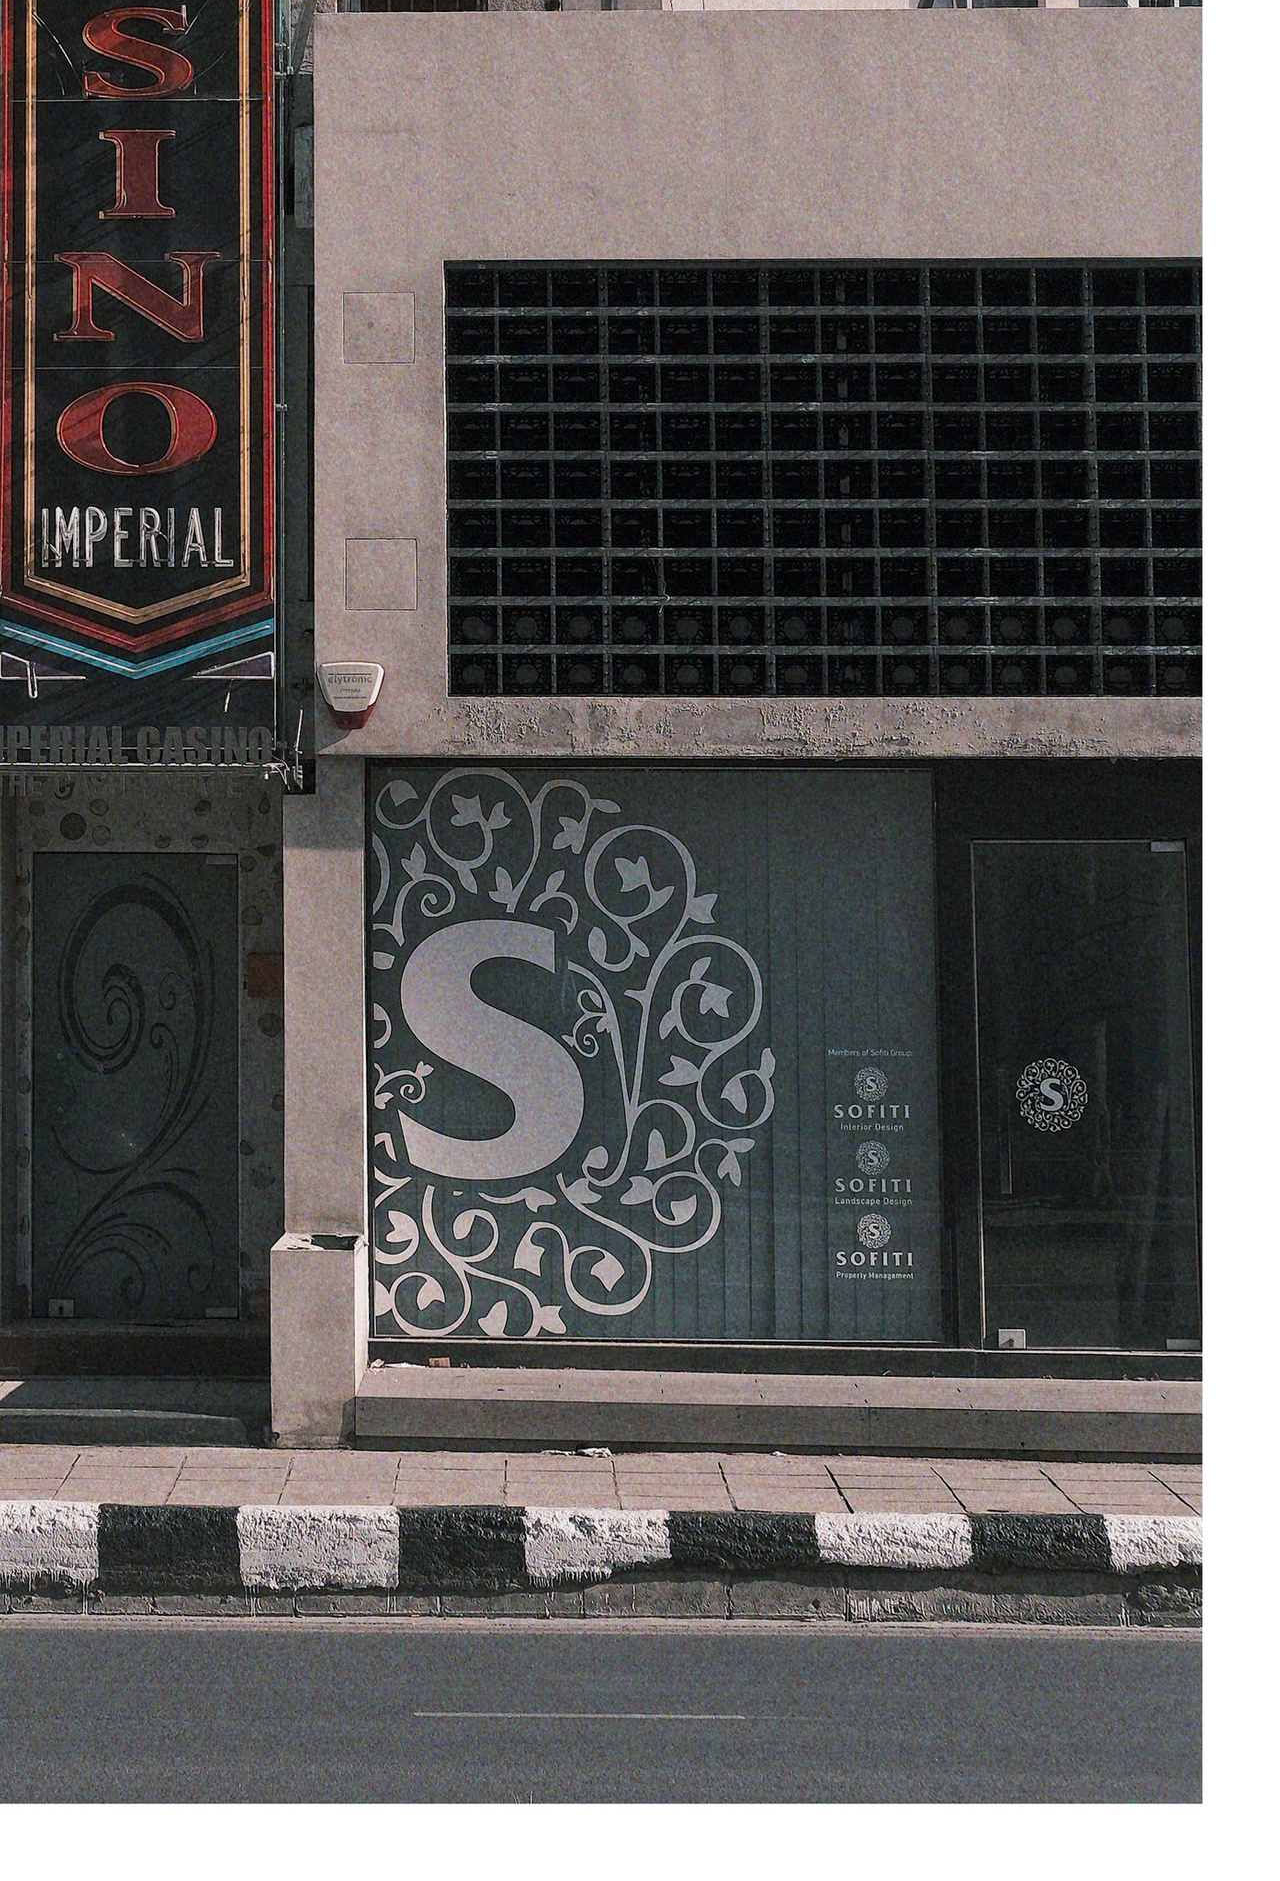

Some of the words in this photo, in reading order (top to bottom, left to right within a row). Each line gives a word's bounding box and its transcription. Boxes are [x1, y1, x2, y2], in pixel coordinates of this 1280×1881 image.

[41, 506, 234, 568] IMPERIAL
[136, 725, 273, 764] CASINO
[833, 1104, 910, 1119] SOFITI
[840, 1123, 872, 1131] Interior
[875, 1123, 904, 1133] Design
[835, 1178, 912, 1193] SOFITI
[835, 1197, 880, 1206] Landscape
[883, 1197, 913, 1207] Design
[836, 1251, 914, 1267] SOFITI
[836, 1271, 867, 1281] Property
[868, 1272, 914, 1281] Management
